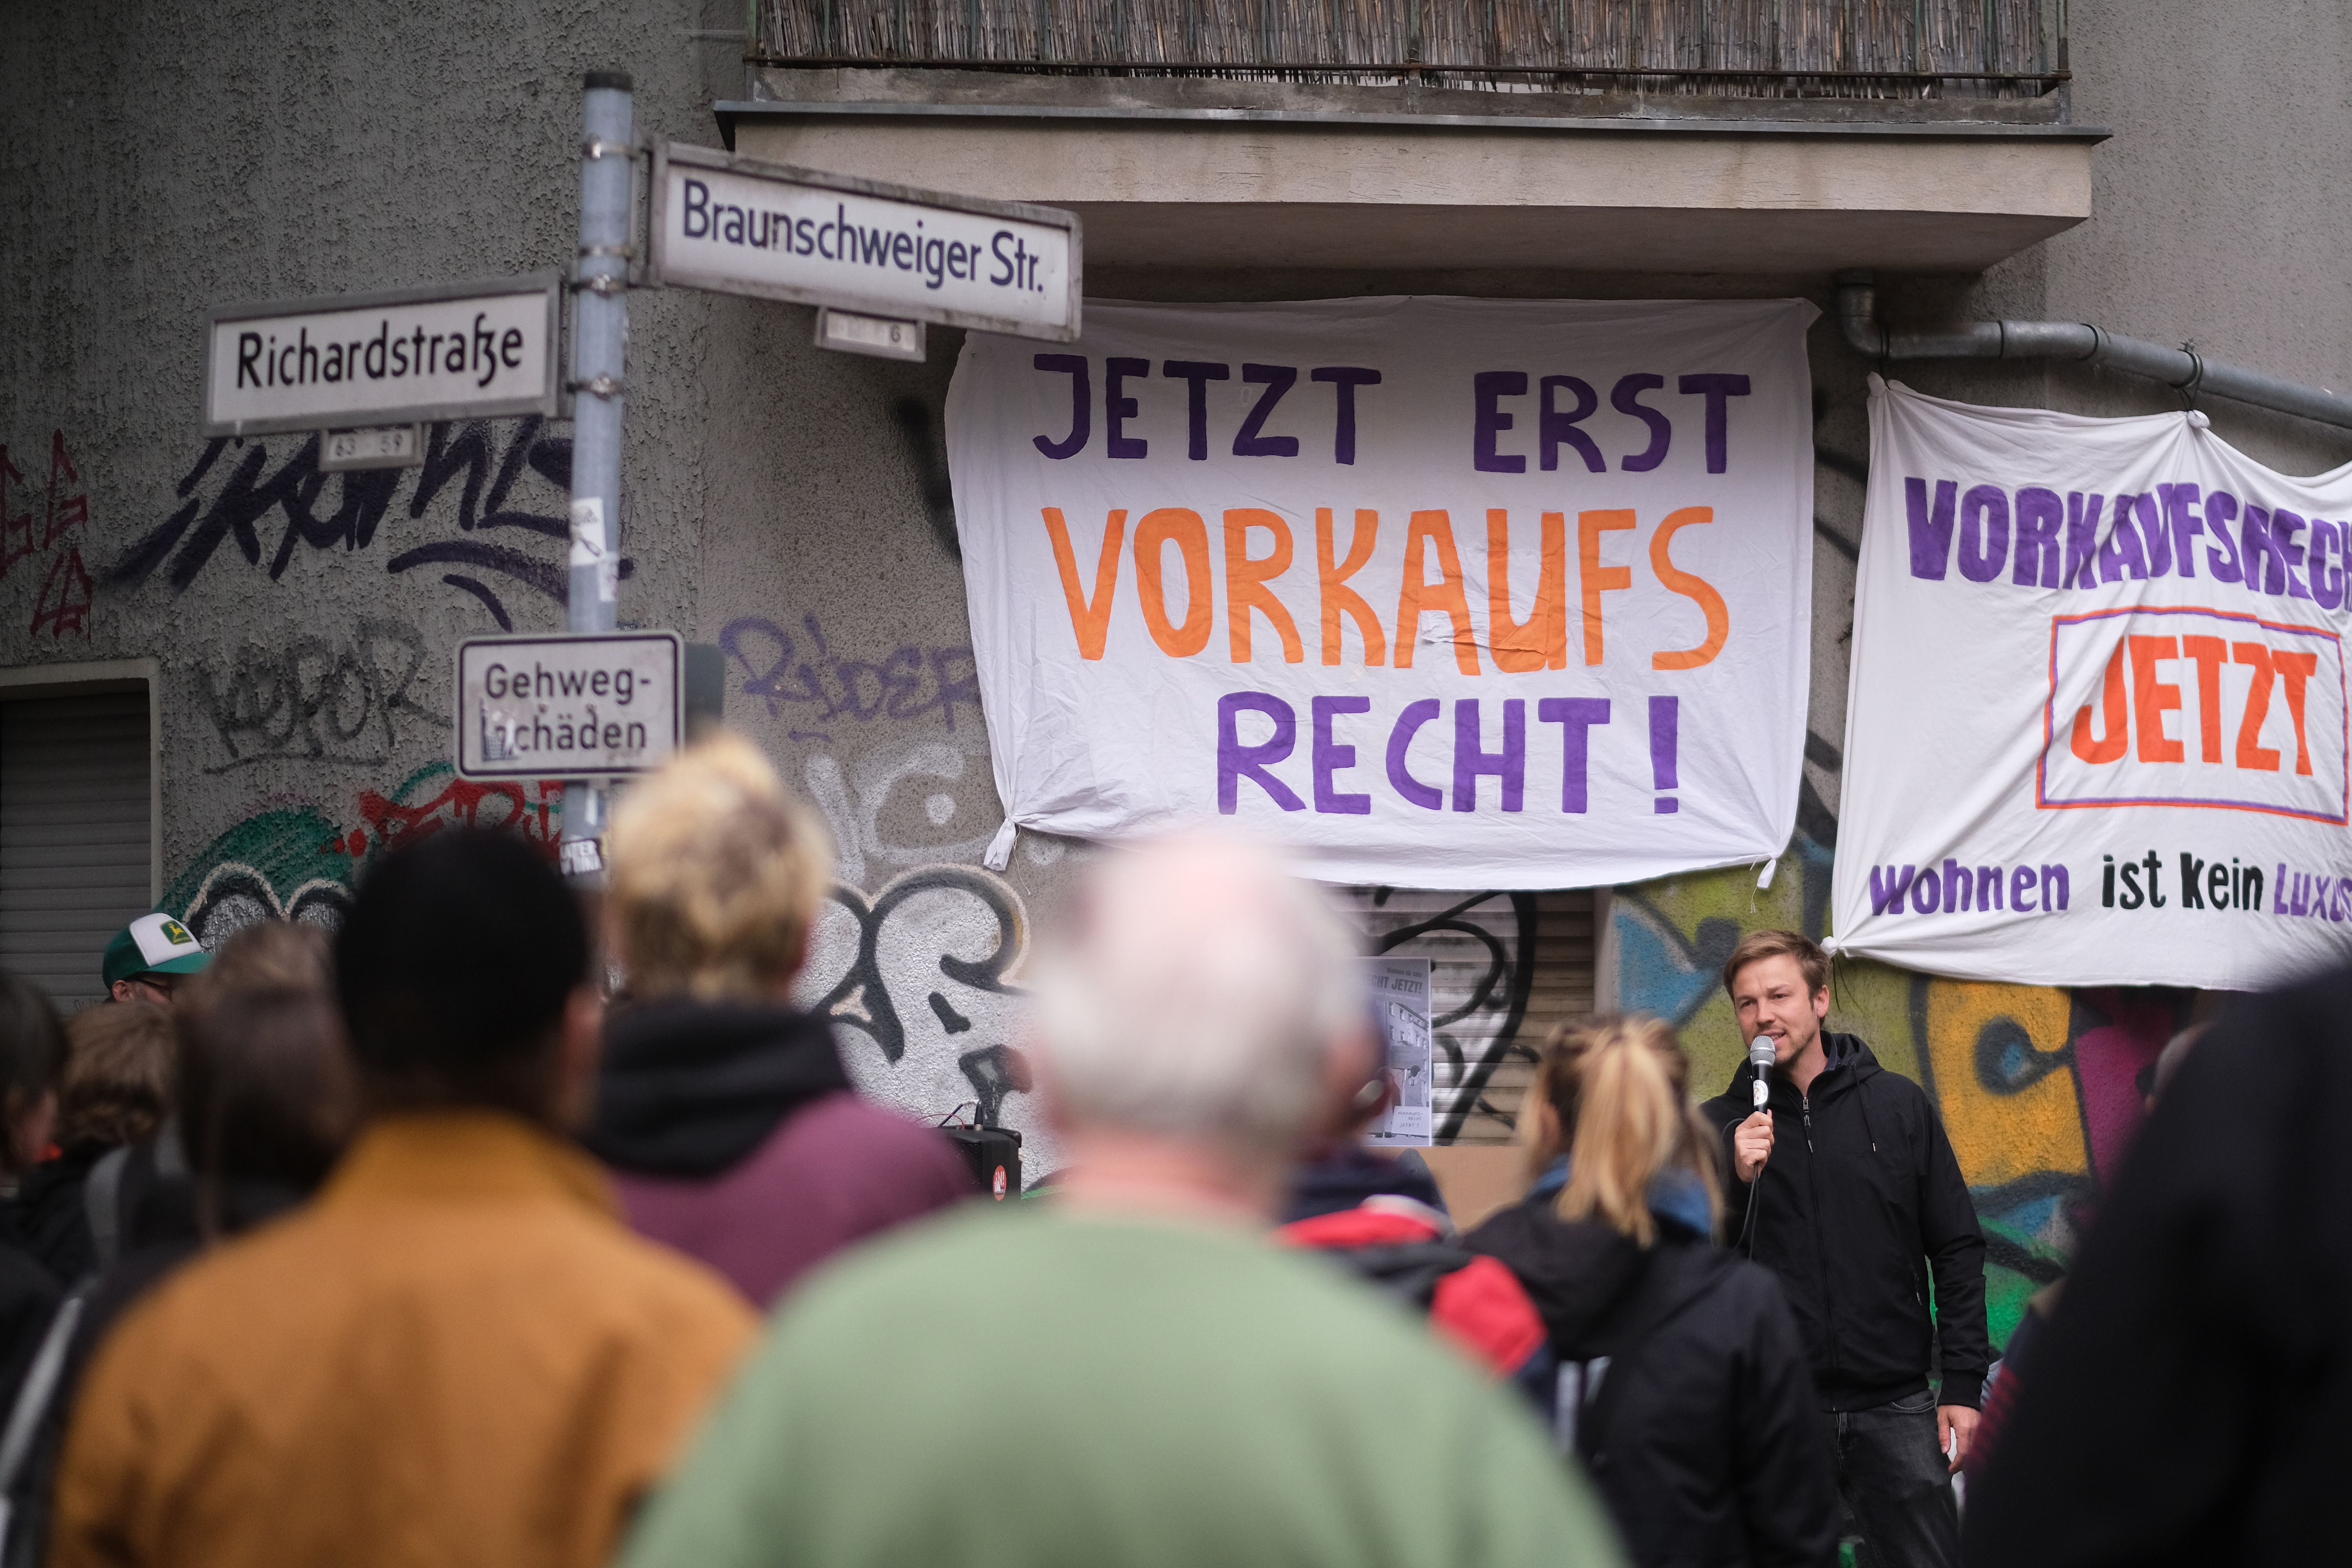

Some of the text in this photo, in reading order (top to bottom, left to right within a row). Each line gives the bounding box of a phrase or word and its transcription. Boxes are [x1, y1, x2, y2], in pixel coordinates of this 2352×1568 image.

[682, 179, 1044, 292] Braunschweiger Str.
[236, 312, 524, 389] Richardstraße
[889, 324, 901, 343] 6
[1033, 354, 1750, 474] JETZT ERST
[1041, 506, 1729, 675] VORKAUFS
[485, 661, 652, 705] Gehweg-
[2070, 633, 2317, 776] JETZT
[1869, 858, 2070, 916] wohnen
[2102, 849, 2167, 909] ist
[1392, 978, 1423, 994] JETZT!
